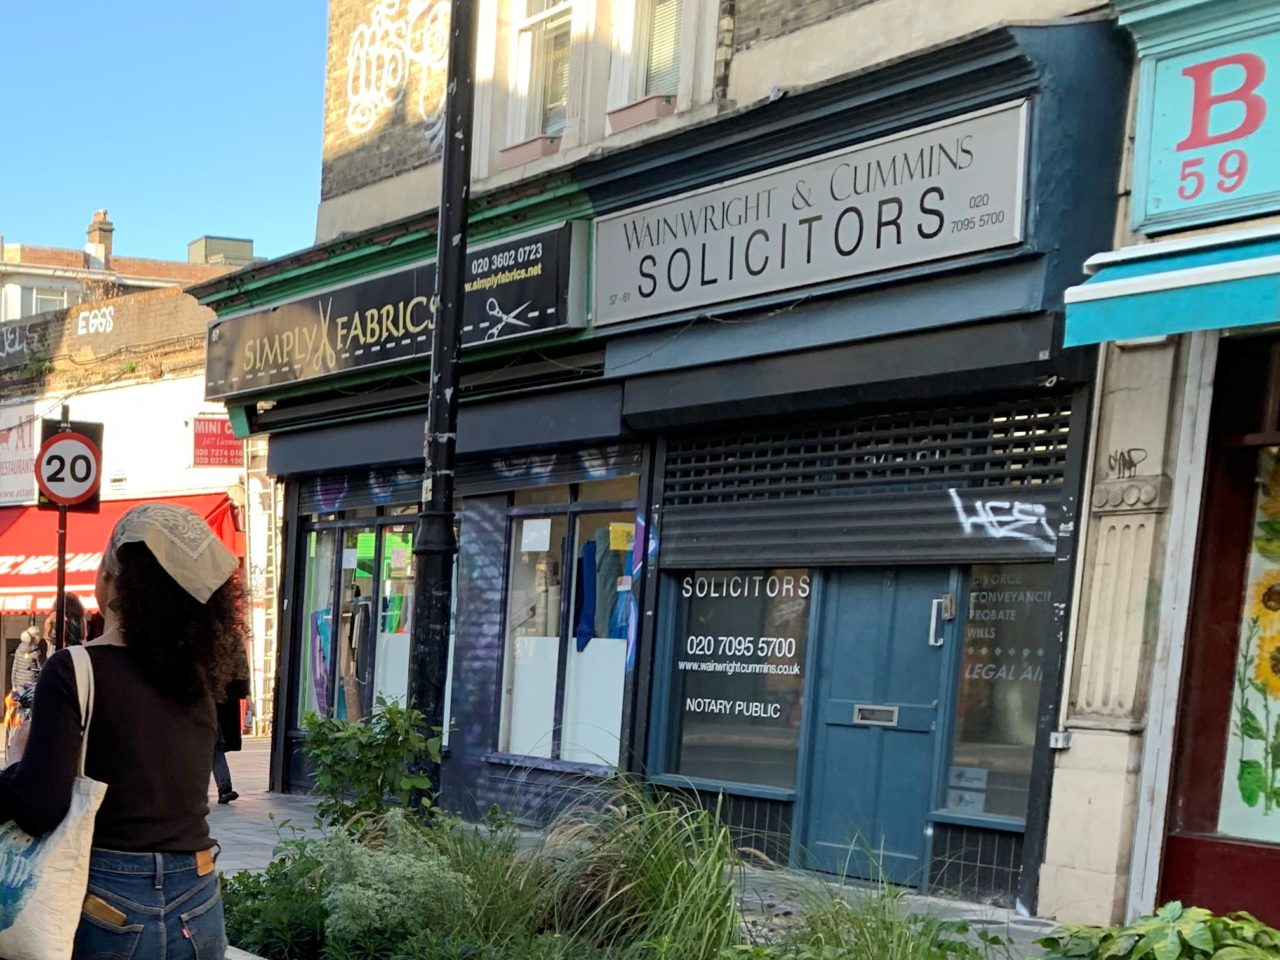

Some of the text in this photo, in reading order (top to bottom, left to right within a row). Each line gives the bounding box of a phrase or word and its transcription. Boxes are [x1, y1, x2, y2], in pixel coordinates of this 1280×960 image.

[1175, 52, 1267, 152] B
[1177, 149, 1249, 200] 59
[624, 135, 974, 253] WAINWRIGHT & CUMMINS
[969, 193, 989, 209] 020
[951, 210, 1005, 234] 7095 5700
[638, 186, 945, 298] SOLICITORS
[471, 243, 543, 274] 020 3602 0723
[243, 323, 318, 371] SIMPLY
[195, 420, 221, 434] MINI
[45, 454, 92, 483] 20
[682, 575, 811, 598] SOLICITORS
[969, 609, 1017, 621] PROBATE
[967, 627, 996, 639] WILLS
[687, 636, 796, 658] 020 7095 5700
[678, 659, 801, 675] www.wainwrightcummins.co.uk
[965, 663, 1015, 680] LEGAL
[686, 698, 781, 719] NOTARY PUBLIC
